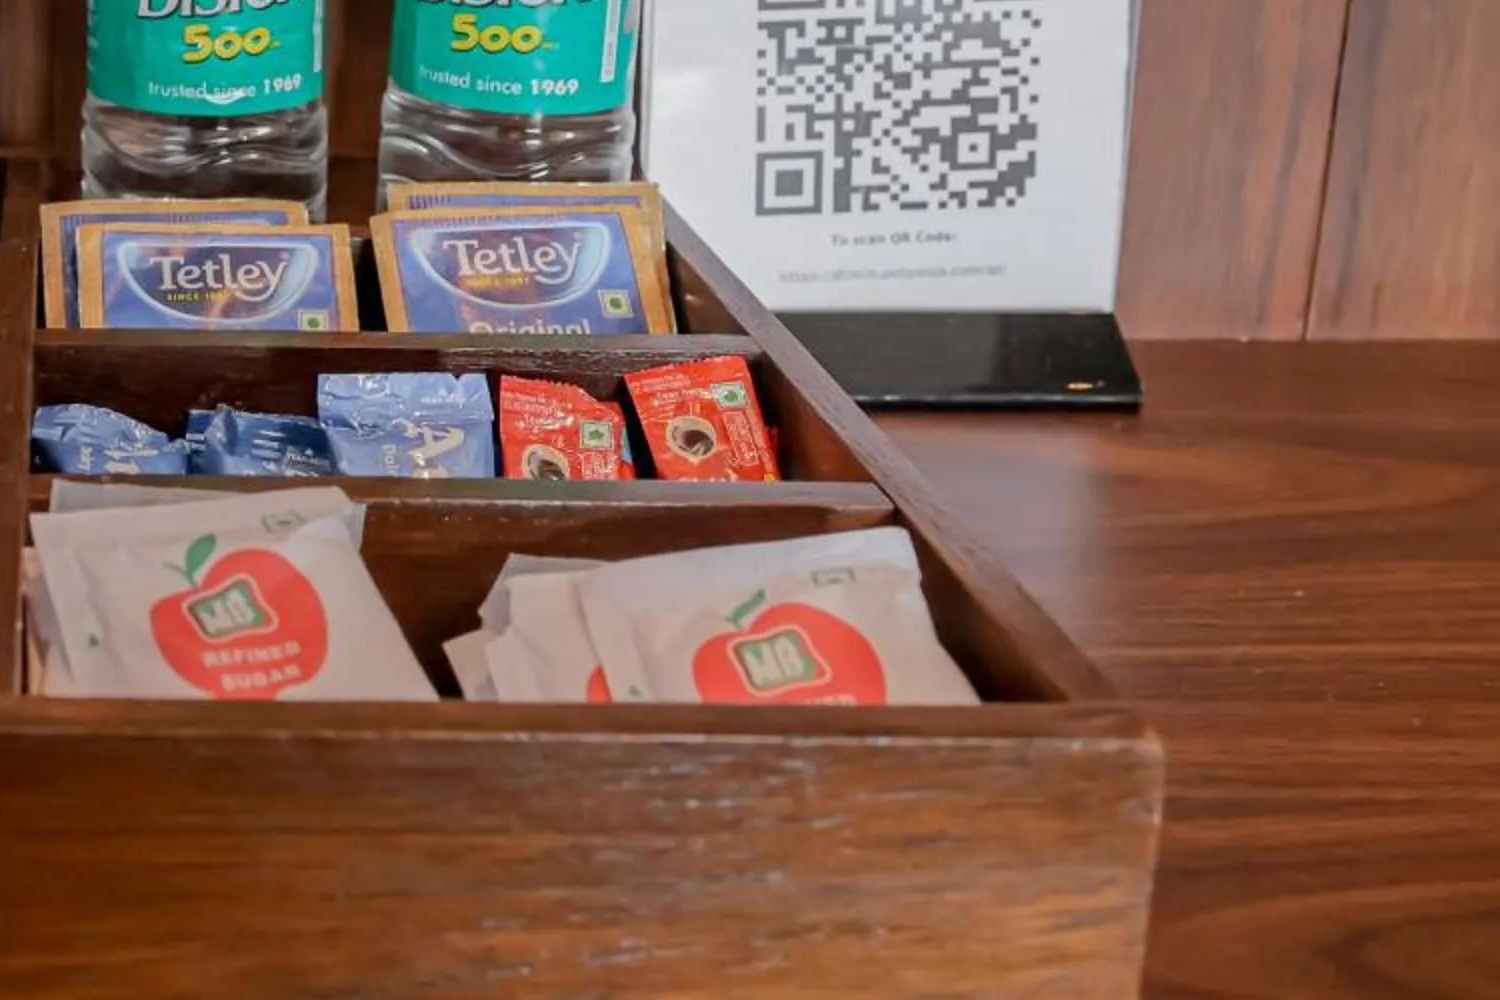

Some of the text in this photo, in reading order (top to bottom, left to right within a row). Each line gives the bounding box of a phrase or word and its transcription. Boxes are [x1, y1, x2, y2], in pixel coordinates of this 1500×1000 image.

[182, 23, 272, 63] 500
[450, 13, 543, 54] 500
[148, 80, 207, 98] trusted
[263, 73, 302, 95] 1969
[419, 64, 580, 96] trusted since 1969
[890, 230, 911, 245] QR
[443, 236, 584, 285] Tetley
[148, 253, 289, 302] Tetley
[202, 640, 301, 668] REFINED
[221, 664, 302, 693] SUGAR
